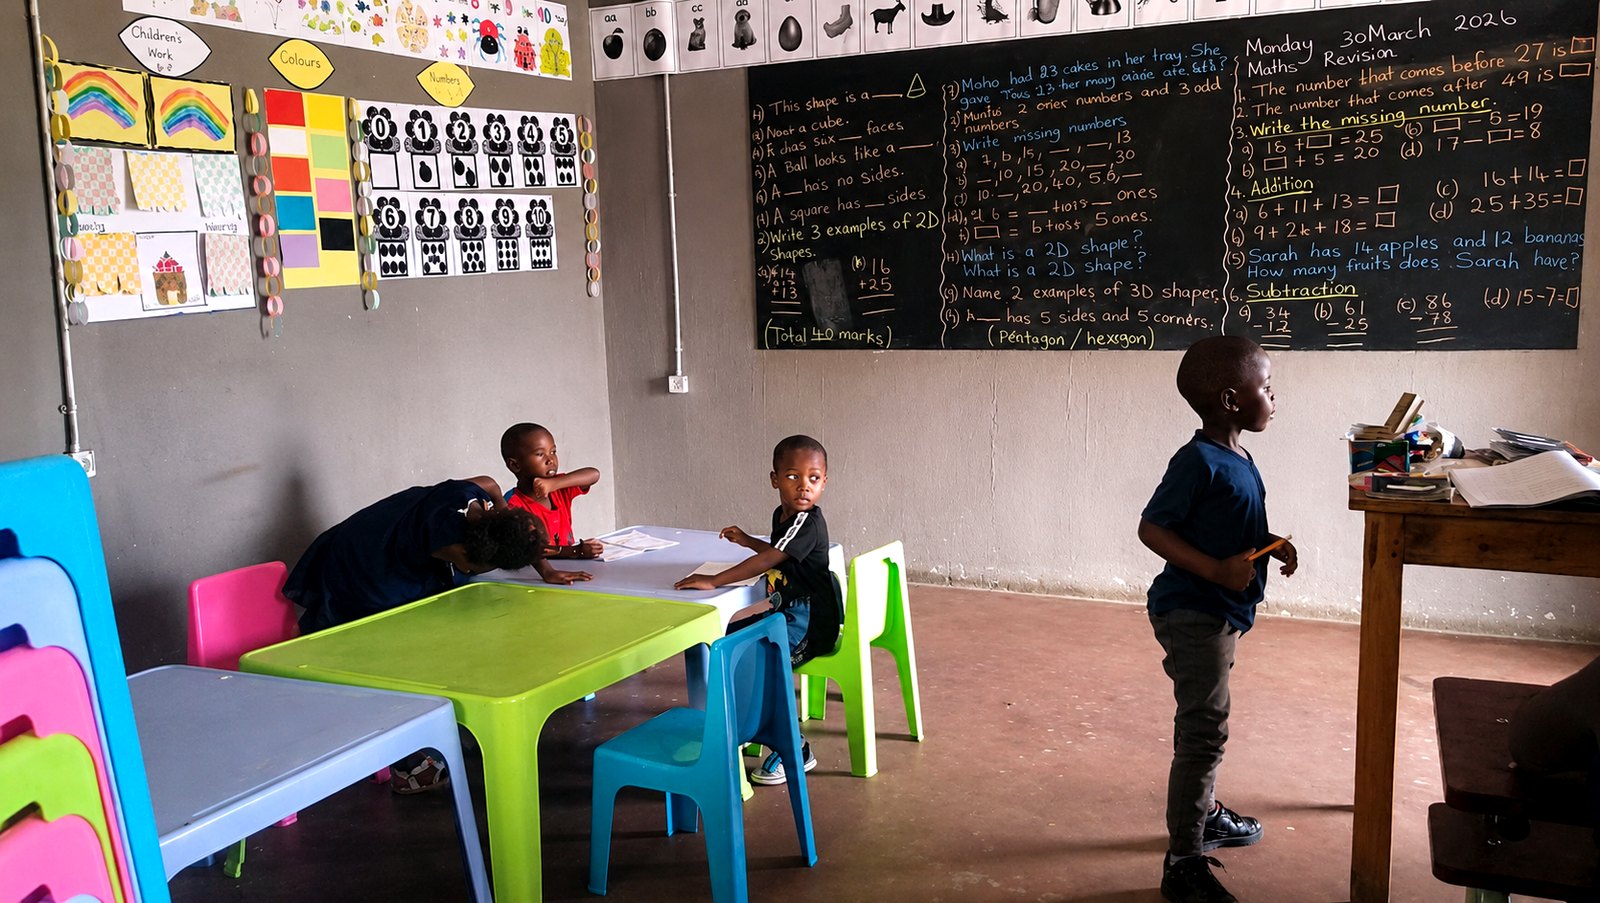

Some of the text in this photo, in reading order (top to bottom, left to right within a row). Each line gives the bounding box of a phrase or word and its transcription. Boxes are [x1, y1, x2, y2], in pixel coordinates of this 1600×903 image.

[645, 8, 657, 17] bb
[691, 4, 703, 12] cc
[604, 14, 617, 23] aa
[131, 25, 182, 44] Children's
[1246, 34, 1313, 64] Monday
[1454, 10, 1517, 31] 2026
[148, 47, 173, 60] Work
[280, 50, 320, 68] Colours
[1248, 47, 1397, 77] Maths Revision
[961, 78, 1000, 93] Moho
[1010, 66, 1032, 85] had
[1040, 64, 1058, 78] 23
[1062, 60, 1099, 75] cakes
[1107, 56, 1122, 70] in
[1124, 52, 1145, 67] her
[1191, 43, 1221, 57] She
[1252, 42, 1567, 97] The number that comes before 27 is
[430, 72, 460, 86] Numbers
[1018, 76, 1222, 114] 2 numbers and 3 odd
[1251, 68, 1554, 117] The number that comes after 49 is
[769, 100, 800, 115] This
[806, 97, 839, 111] shape
[845, 91, 857, 103] is
[960, 94, 991, 111] gave
[376, 117, 385, 137] 0
[811, 115, 849, 131] cube.
[866, 121, 904, 134] faces
[965, 119, 1020, 135] numbers
[1250, 119, 1293, 137] Write
[1300, 116, 1332, 130] the
[1341, 109, 1405, 128] missing
[1405, 102, 1543, 139] (b) 19
[418, 121, 427, 140] 1
[457, 122, 466, 140] 2
[494, 123, 502, 141] 3
[527, 125, 535, 142] 4
[559, 126, 566, 143] 5
[963, 138, 1000, 151] Write
[1068, 116, 1127, 134] numbers
[1117, 130, 1131, 144] 13
[1355, 129, 1383, 144] 25
[1400, 121, 1542, 160] (d) 17 8
[768, 163, 777, 178] A
[785, 156, 807, 174] Ball
[814, 152, 846, 168] looks
[886, 144, 895, 153] a
[1115, 150, 1135, 165] 30
[1354, 147, 1380, 159] 20
[1484, 165, 1549, 188] 16 14
[772, 184, 781, 200] A
[837, 176, 853, 187] no
[1117, 187, 1158, 201] ones
[1251, 176, 1314, 196] Addition
[774, 186, 926, 226] A square has sides
[1295, 193, 1353, 214] 11 13
[1470, 192, 1549, 213] 25 35
[385, 209, 395, 227] 6
[427, 209, 436, 227] 7
[465, 209, 474, 227] 8
[502, 209, 510, 226] 9
[534, 209, 544, 226] 10
[811, 224, 821, 240] 3
[826, 217, 886, 239] examples
[893, 212, 912, 229] of
[915, 211, 940, 229] 2D
[1335, 219, 1351, 234] 18
[961, 248, 994, 263] What
[1002, 247, 1015, 259] is
[1045, 242, 1069, 258] 2D
[1249, 244, 1298, 264] Sarah
[1310, 242, 1341, 257] has
[1354, 242, 1373, 255] 14
[1379, 235, 1439, 259] apples
[1453, 230, 1486, 249] and
[1495, 231, 1513, 247] 12
[872, 258, 891, 275] 16
[963, 264, 1000, 277] What
[1007, 264, 1019, 277] is
[1047, 262, 1075, 276] 2D
[1248, 249, 1579, 281] How many fruits does Sarah have?
[962, 281, 1153, 304] Name 2 examples of 3D
[1247, 281, 1356, 298] Subtraction
[1265, 300, 1364, 319] 34 61
[1425, 292, 1452, 310] 86
[1006, 309, 1031, 325] has
[1040, 310, 1051, 325] 5
[1059, 310, 1096, 324] sides
[1102, 307, 1130, 322] and
[1138, 310, 1149, 322] 5
[811, 327, 834, 341] 40
